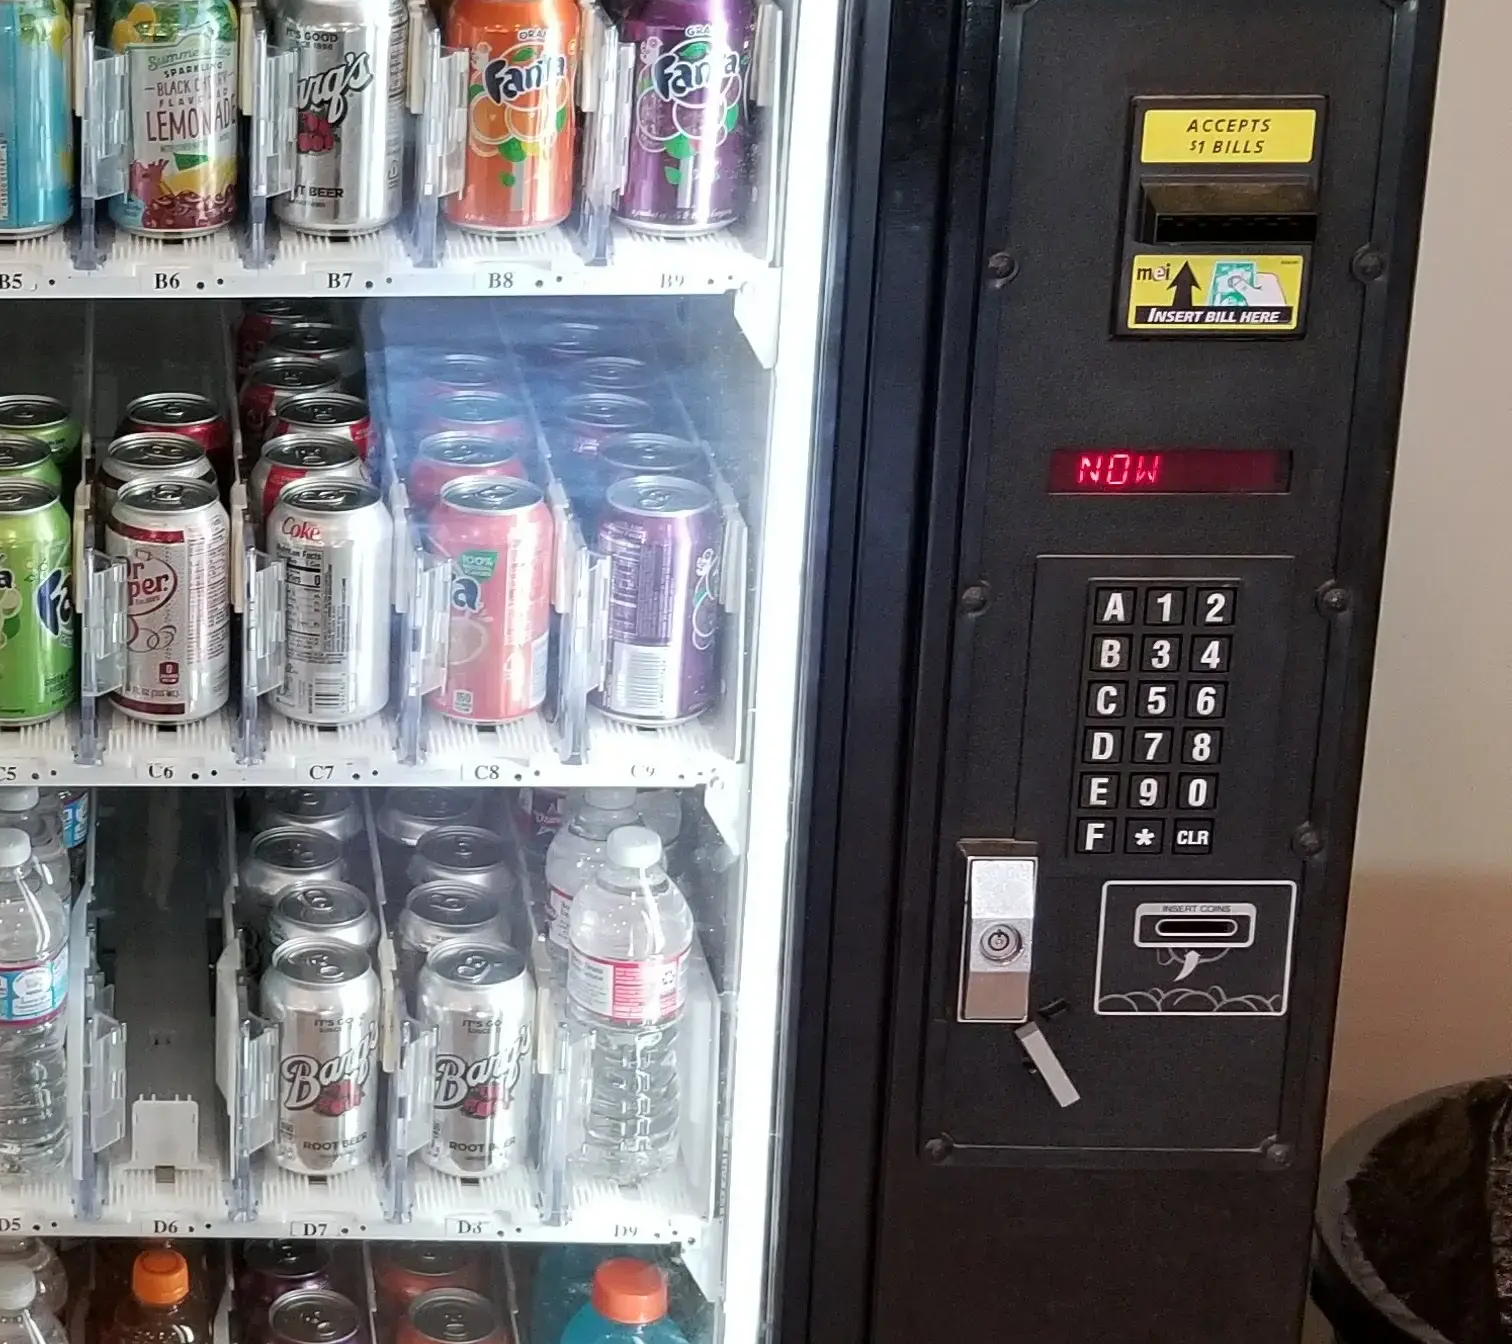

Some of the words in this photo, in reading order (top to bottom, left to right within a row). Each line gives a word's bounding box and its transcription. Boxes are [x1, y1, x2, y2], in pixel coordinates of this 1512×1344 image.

[305, 32, 338, 42] GOOD
[157, 81, 190, 96] BLACK
[1187, 119, 1271, 133] ACCEPTS
[1190, 140, 1205, 153] $1
[1213, 140, 1265, 154] BILLS
[309, 187, 344, 198] BEER
[1138, 263, 1170, 280] mei
[154, 273, 180, 289] B6
[327, 272, 353, 289] B7
[488, 272, 514, 290] B8
[1148, 310, 1204, 323] INSERT
[1205, 311, 1237, 323] BILL
[1240, 311, 1280, 323] HERE
[1077, 454, 1162, 485] NOW
[281, 516, 320, 541] Coke
[1102, 593, 1126, 622] A
[1157, 594, 1172, 621] 1
[1206, 594, 1225, 622] 2
[1100, 639, 1121, 668] B
[1151, 640, 1170, 669] 3
[1201, 640, 1221, 668] 4
[1096, 685, 1117, 715] C
[1146, 686, 1167, 714] 5
[1196, 685, 1216, 714] 6
[1092, 732, 1115, 760] D
[1144, 732, 1162, 759] 7
[1191, 732, 1211, 761] 8
[149, 764, 173, 779] C6
[309, 765, 333, 781] C7
[474, 764, 500, 781] C8
[1089, 777, 1109, 805] E
[1139, 777, 1158, 806] 9
[1189, 778, 1206, 806] 0
[1085, 823, 1105, 850] F
[1176, 829, 1209, 847] CLR
[314, 1019, 334, 1027] IT'S
[462, 1019, 483, 1027] IT'S
[303, 1141, 338, 1150] ROOT
[342, 1132, 368, 1147] BEER
[449, 1141, 485, 1151] ROOT
[153, 1219, 178, 1234] D6
[303, 1223, 327, 1236] D7
